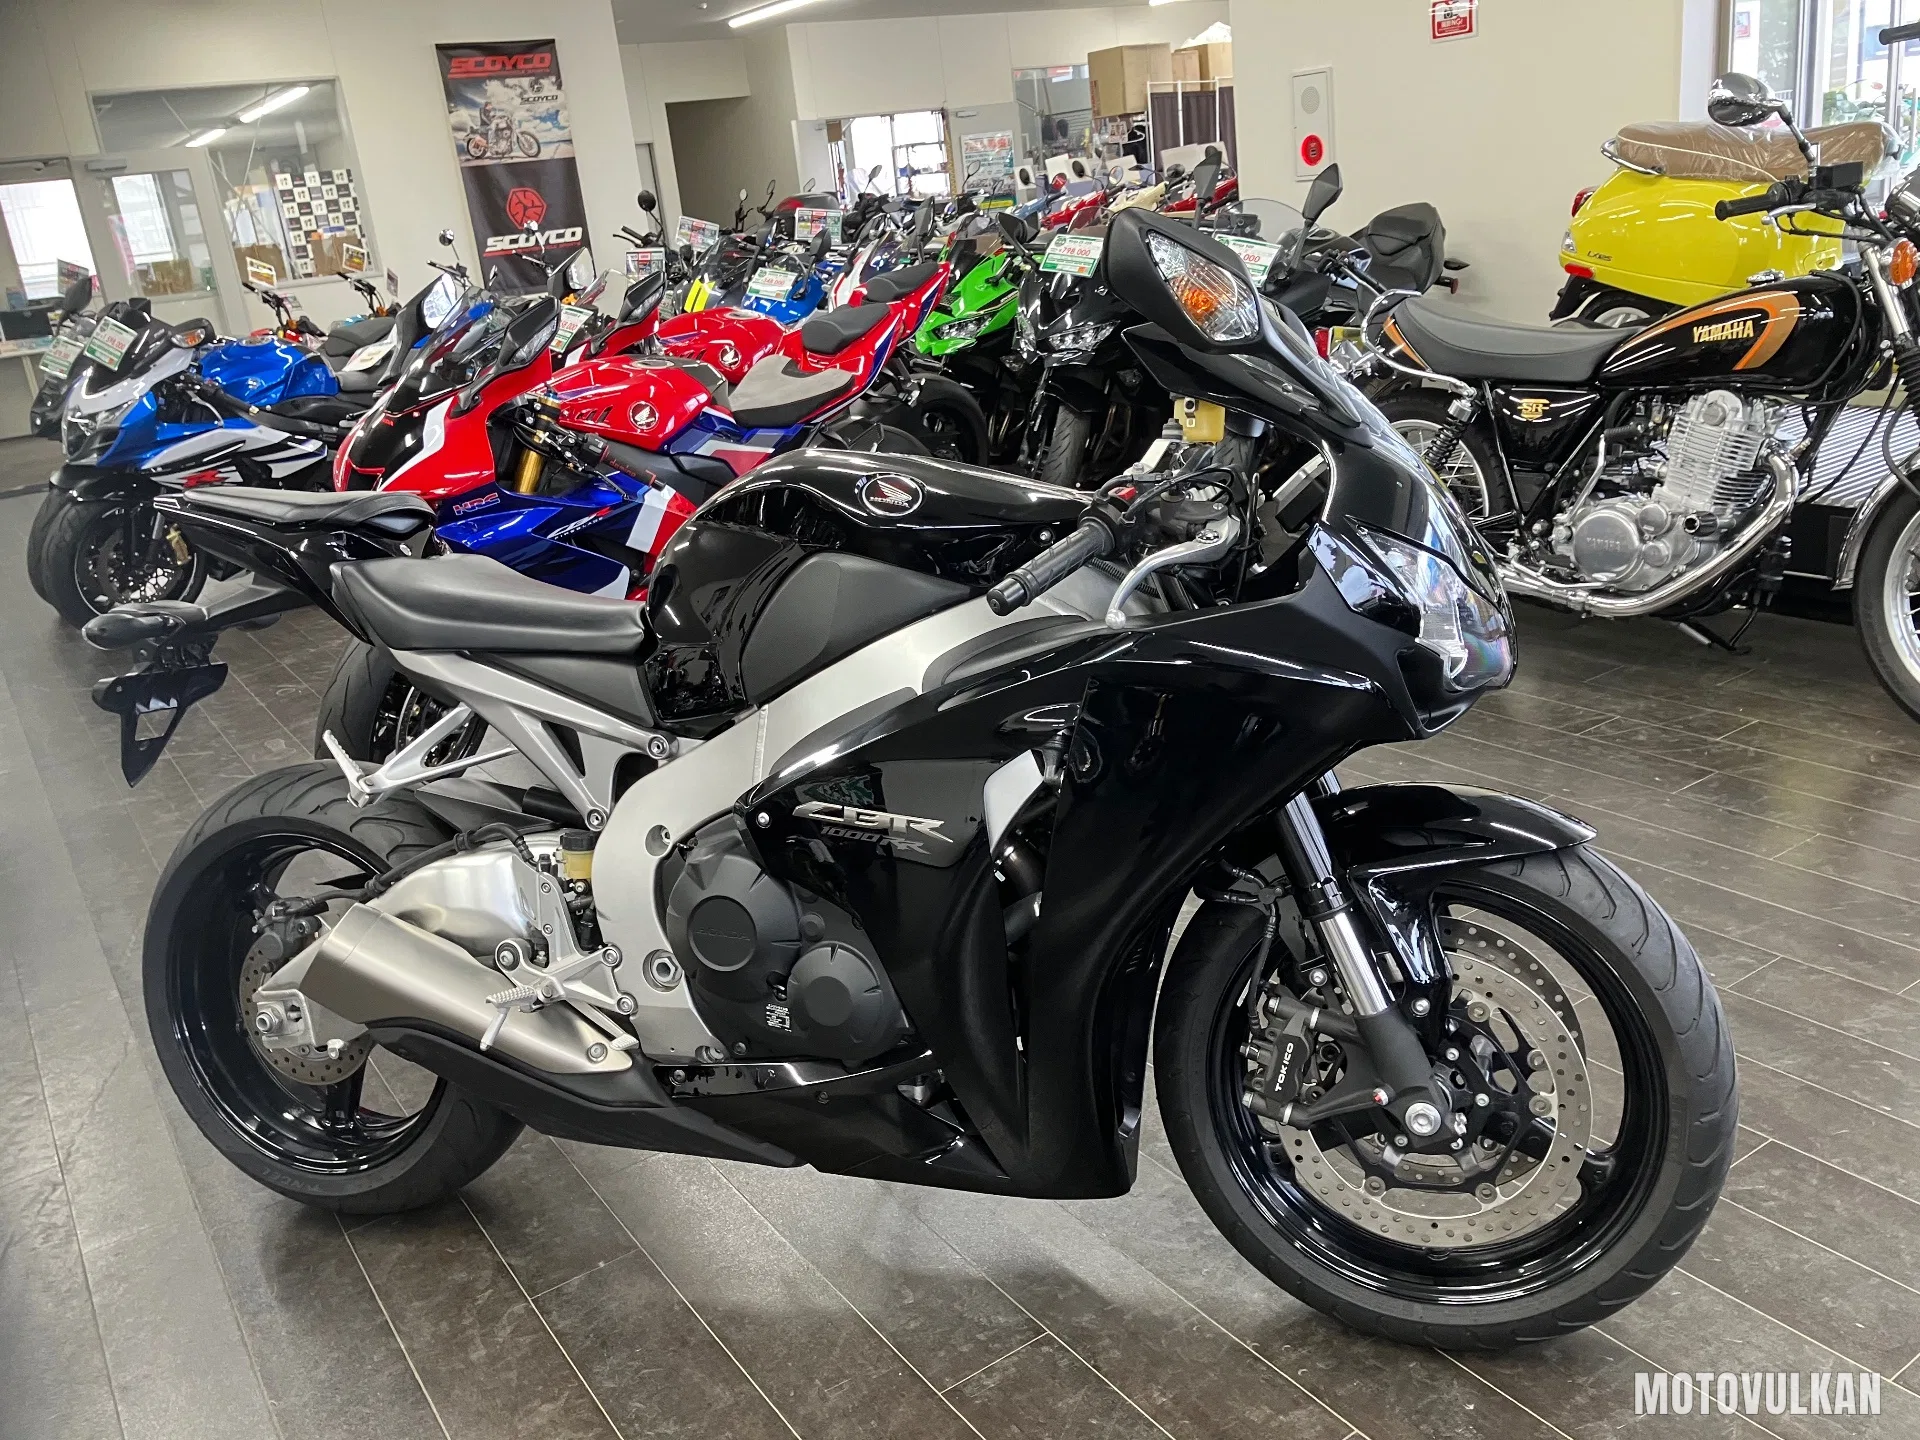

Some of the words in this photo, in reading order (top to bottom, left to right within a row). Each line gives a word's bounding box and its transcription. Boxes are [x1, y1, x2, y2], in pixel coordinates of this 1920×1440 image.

[450, 52, 552, 73] SCOYCO
[520, 94, 559, 103] SCOYCO
[485, 226, 583, 253] SCOYCO
[1693, 320, 1755, 344] YAMAHA
[1521, 402, 1544, 414] SR
[452, 492, 501, 516] HRC
[869, 496, 911, 509] HONDA
[792, 800, 954, 843] CBR
[820, 826, 932, 855] 1000RR
[1274, 1042, 1294, 1092] TOKICO
